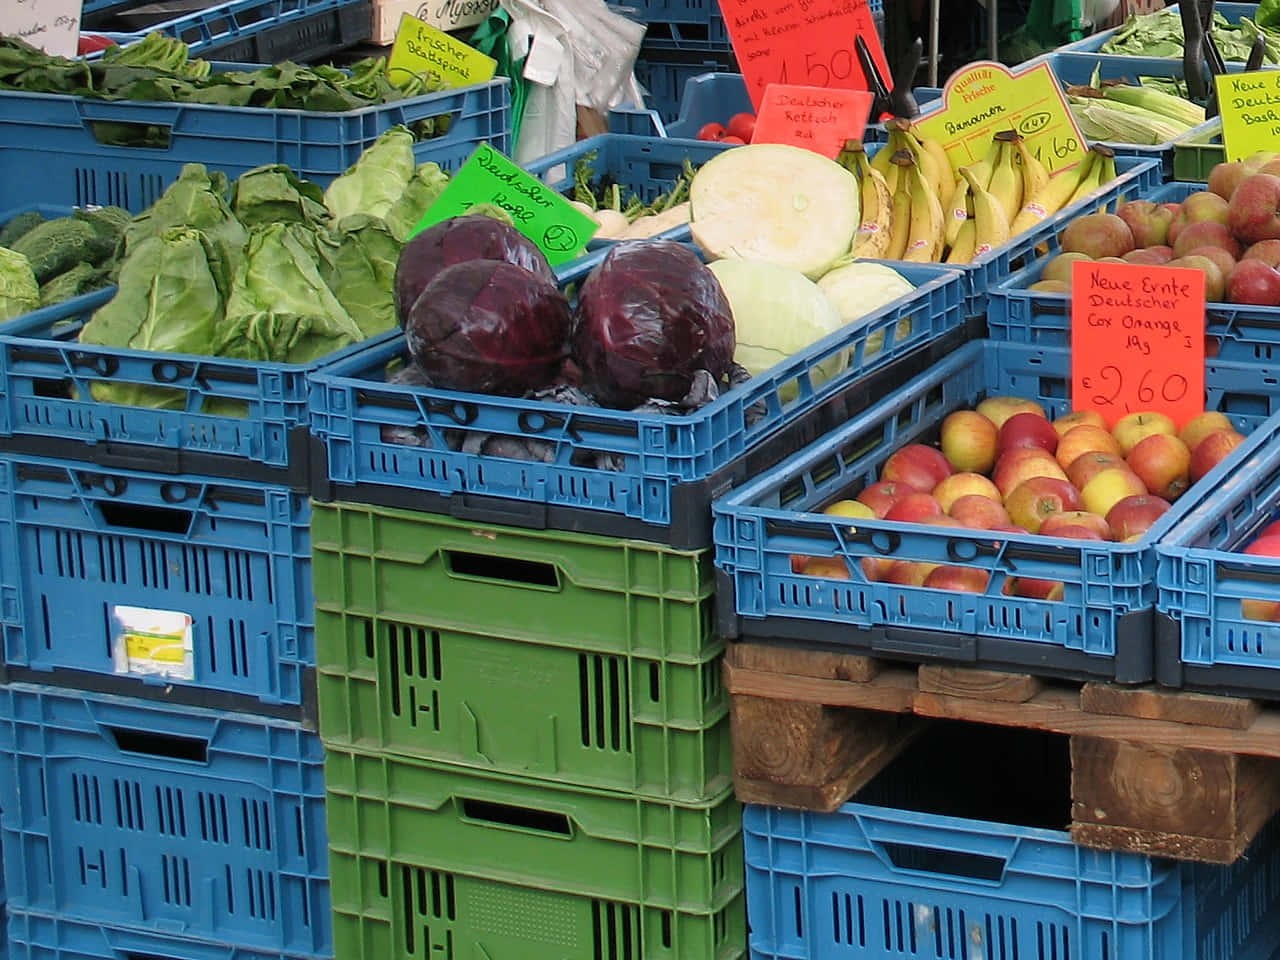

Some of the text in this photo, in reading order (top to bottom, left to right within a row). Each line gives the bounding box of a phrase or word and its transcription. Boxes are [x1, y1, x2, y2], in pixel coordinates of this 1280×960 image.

[954, 70, 993, 95] Qualität
[962, 82, 996, 104] Frische
[1232, 79, 1266, 93] Neue
[776, 95, 843, 110] Deutscher
[945, 104, 1006, 135] Bananen
[1091, 271, 1190, 297] Neue Ernte
[1088, 294, 1180, 310] Deutscher
[1088, 313, 1181, 338] Cox Orange
